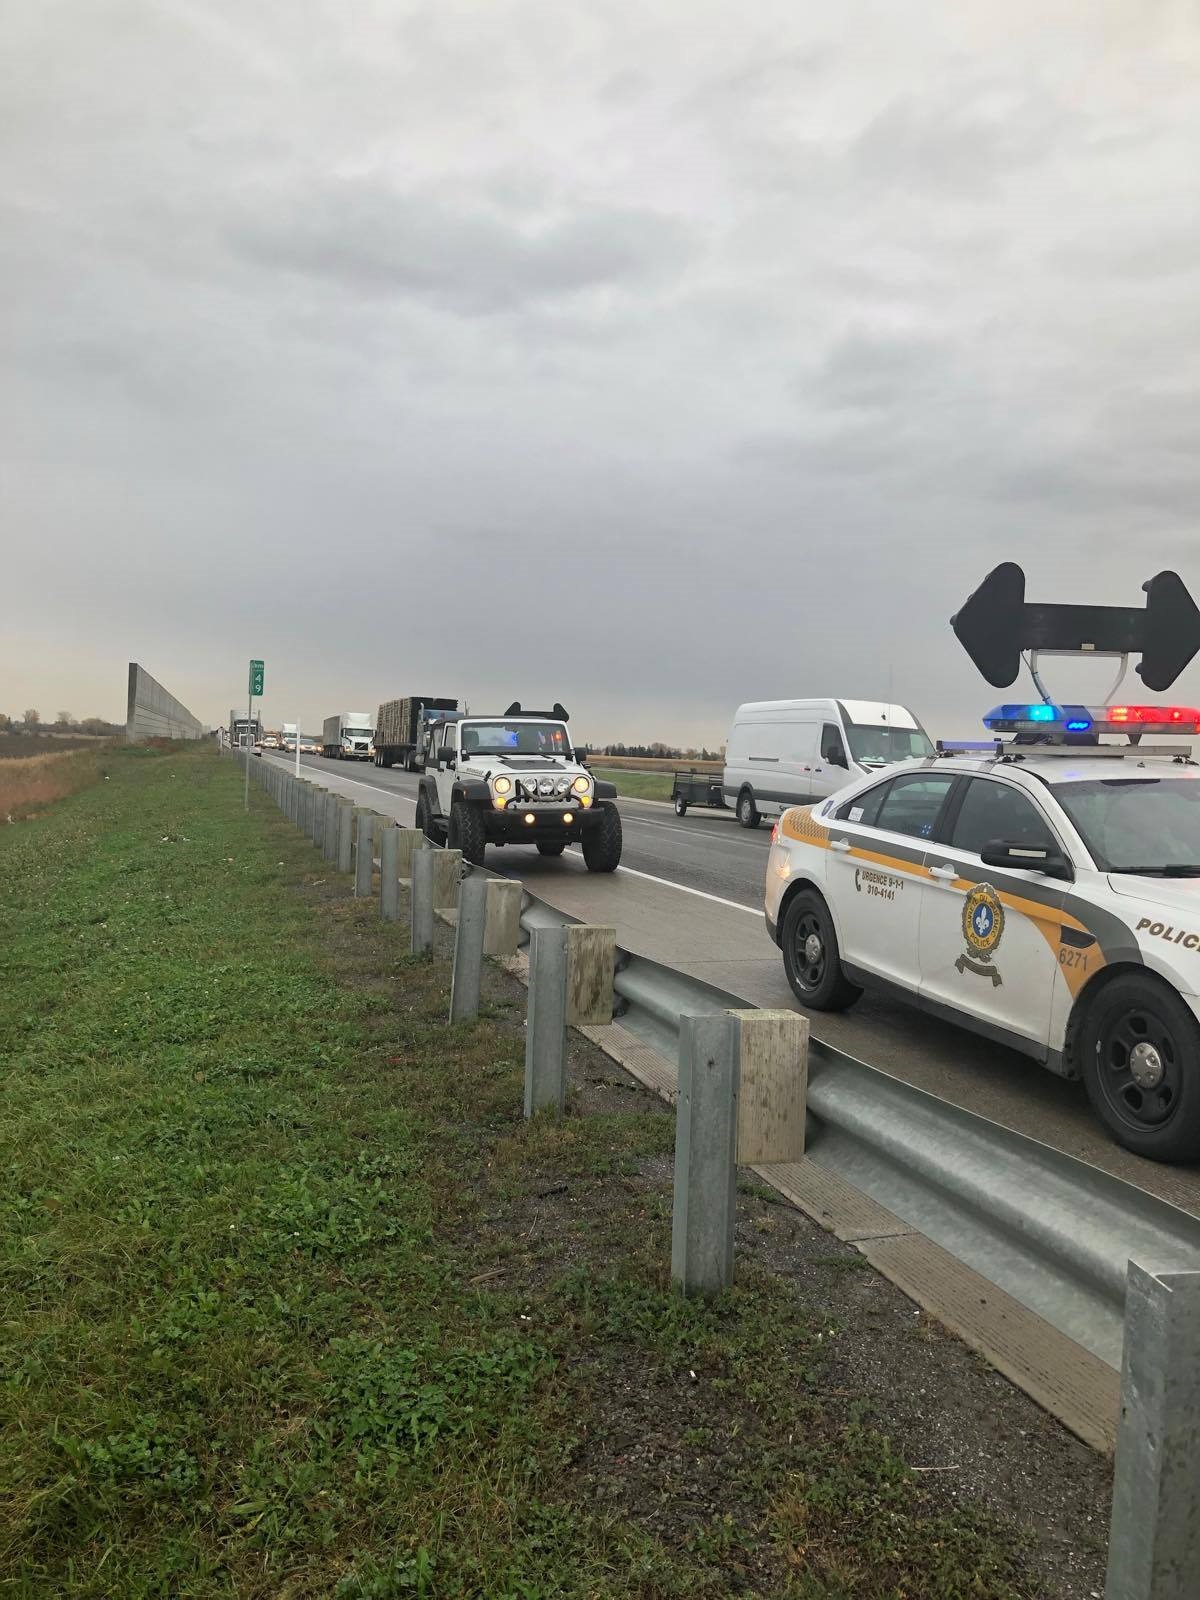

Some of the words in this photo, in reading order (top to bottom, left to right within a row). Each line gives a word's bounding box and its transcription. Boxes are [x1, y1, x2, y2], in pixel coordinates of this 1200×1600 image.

[862, 870, 887, 886] URGENCE
[888, 877, 904, 890] 9-1-1
[867, 884, 895, 901] 310-4141
[1135, 917, 1200, 952] POLIC
[1059, 948, 1088, 971] 6271
